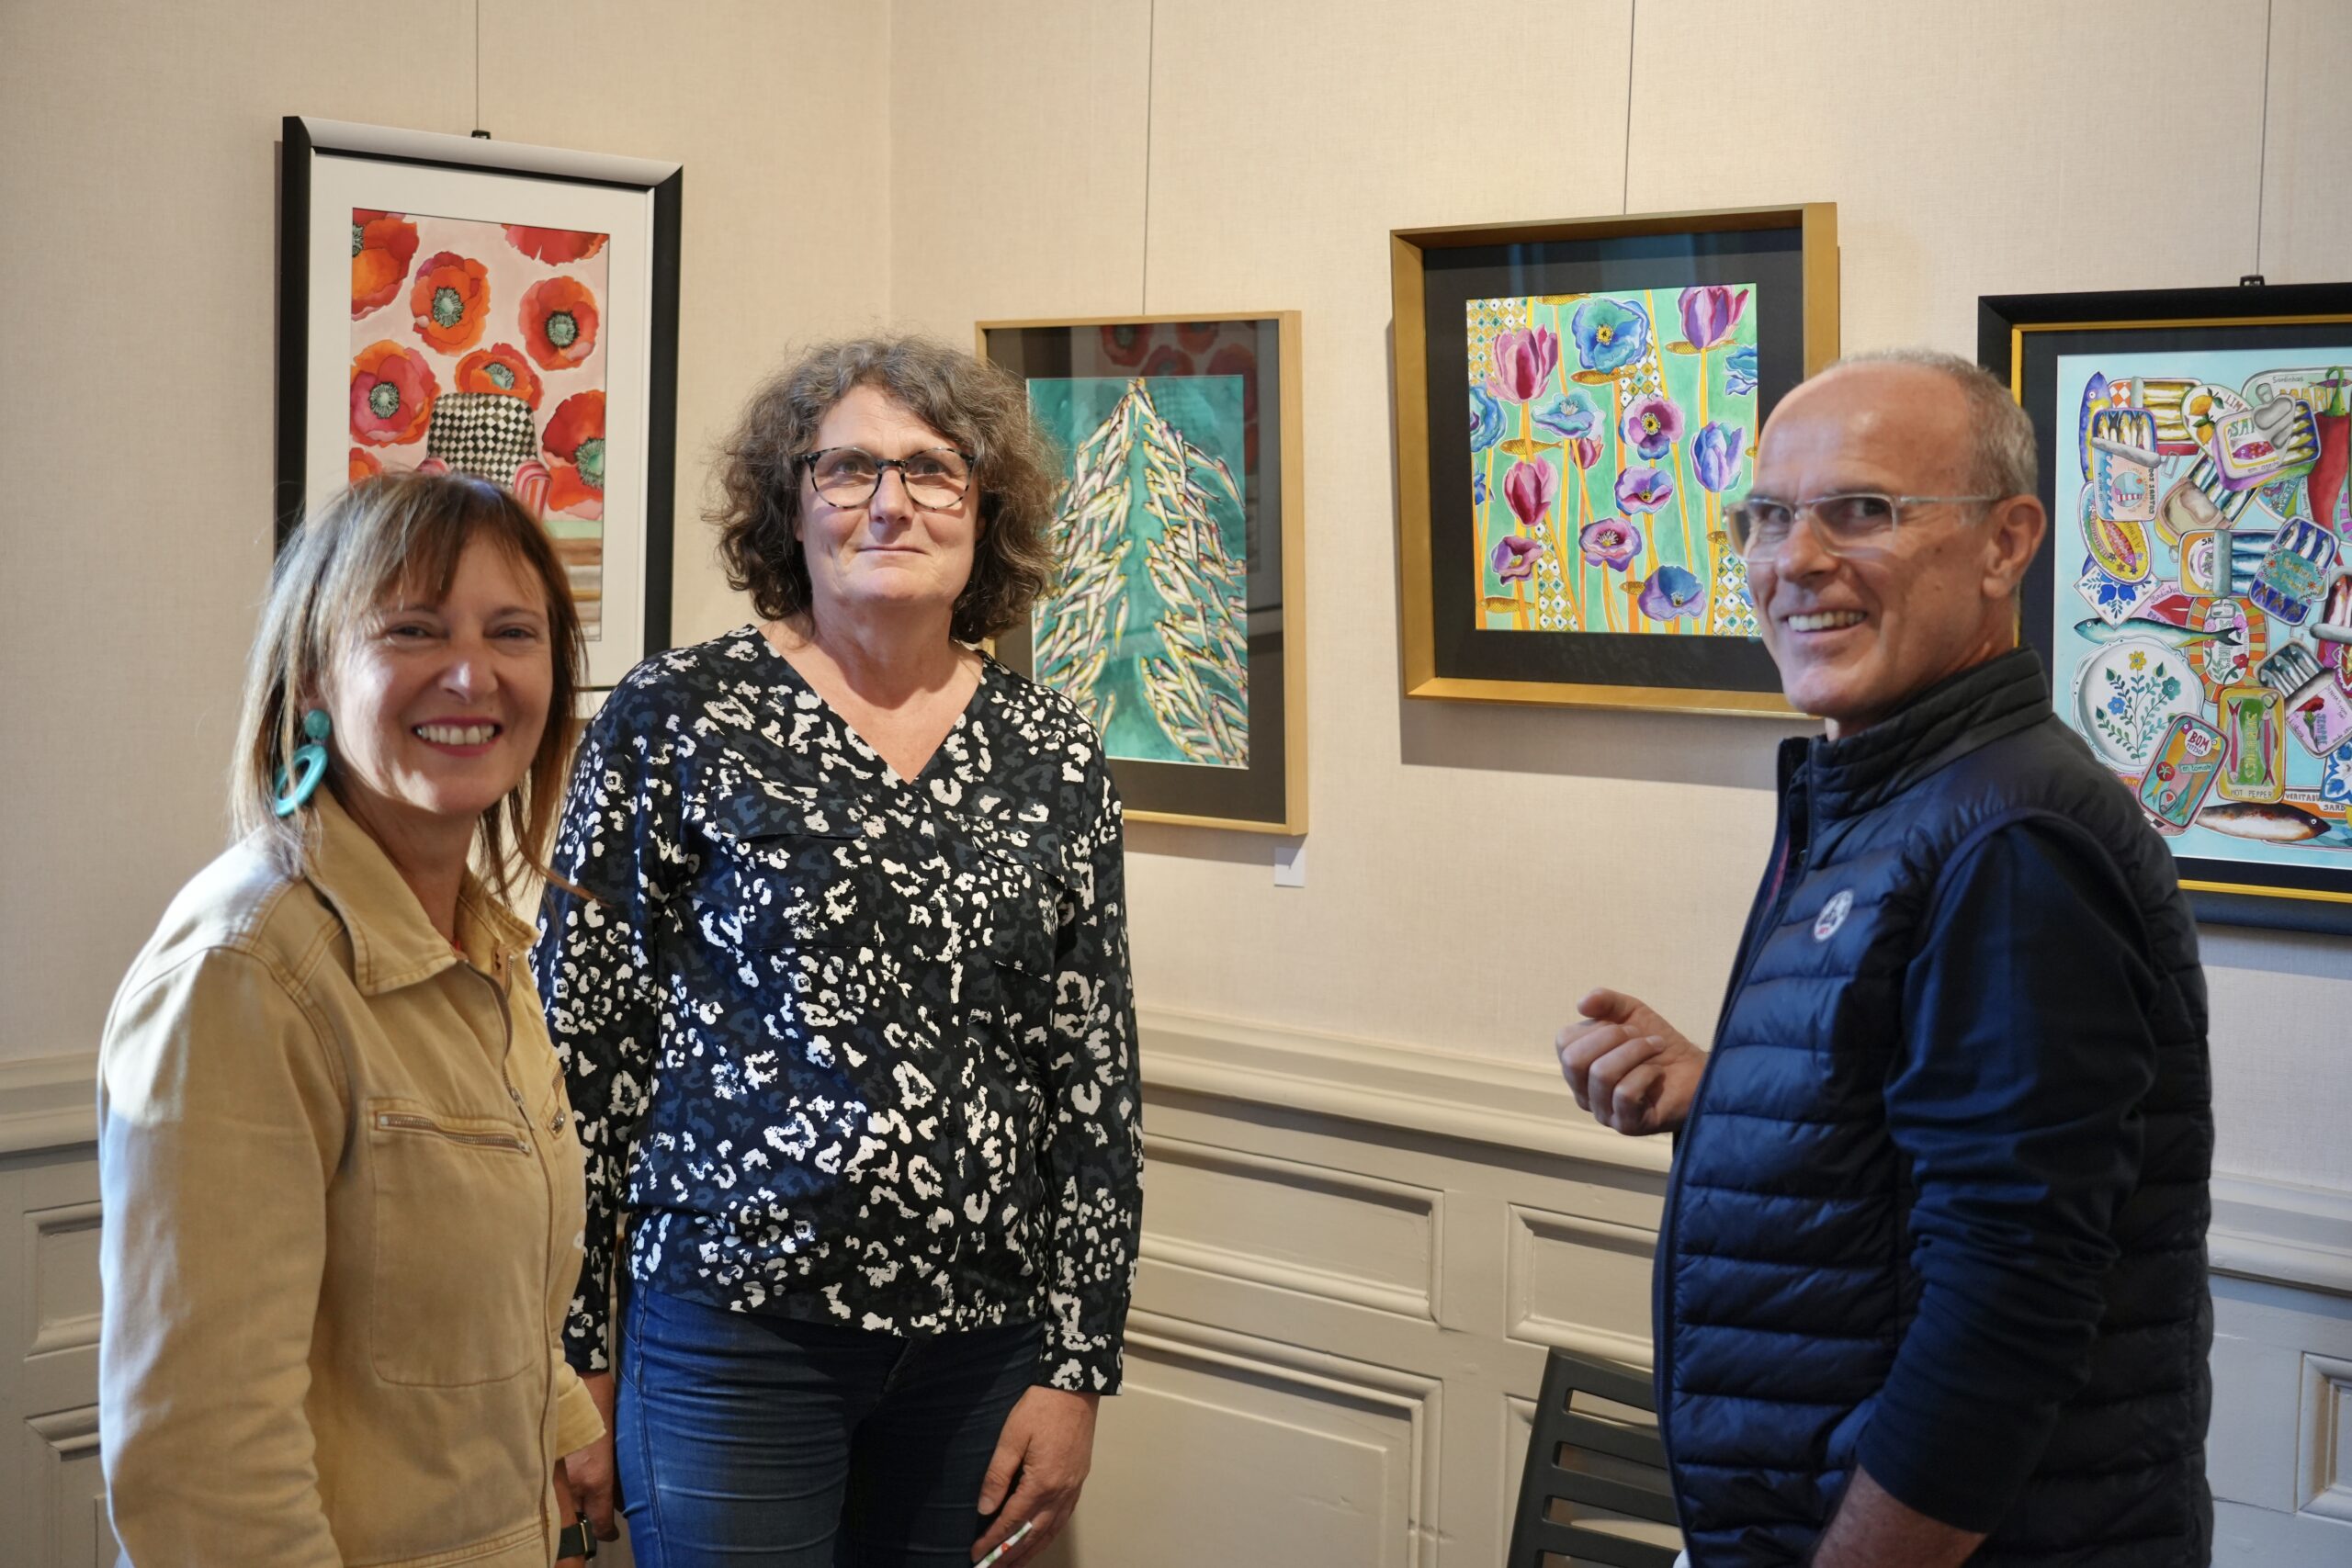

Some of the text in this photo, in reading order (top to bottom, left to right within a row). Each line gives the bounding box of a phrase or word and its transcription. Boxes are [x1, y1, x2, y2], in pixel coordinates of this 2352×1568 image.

[2148, 484, 2156, 514] SANTOS
[2189, 730, 2211, 751] BOM
[2248, 790, 2272, 799] PEPPER
